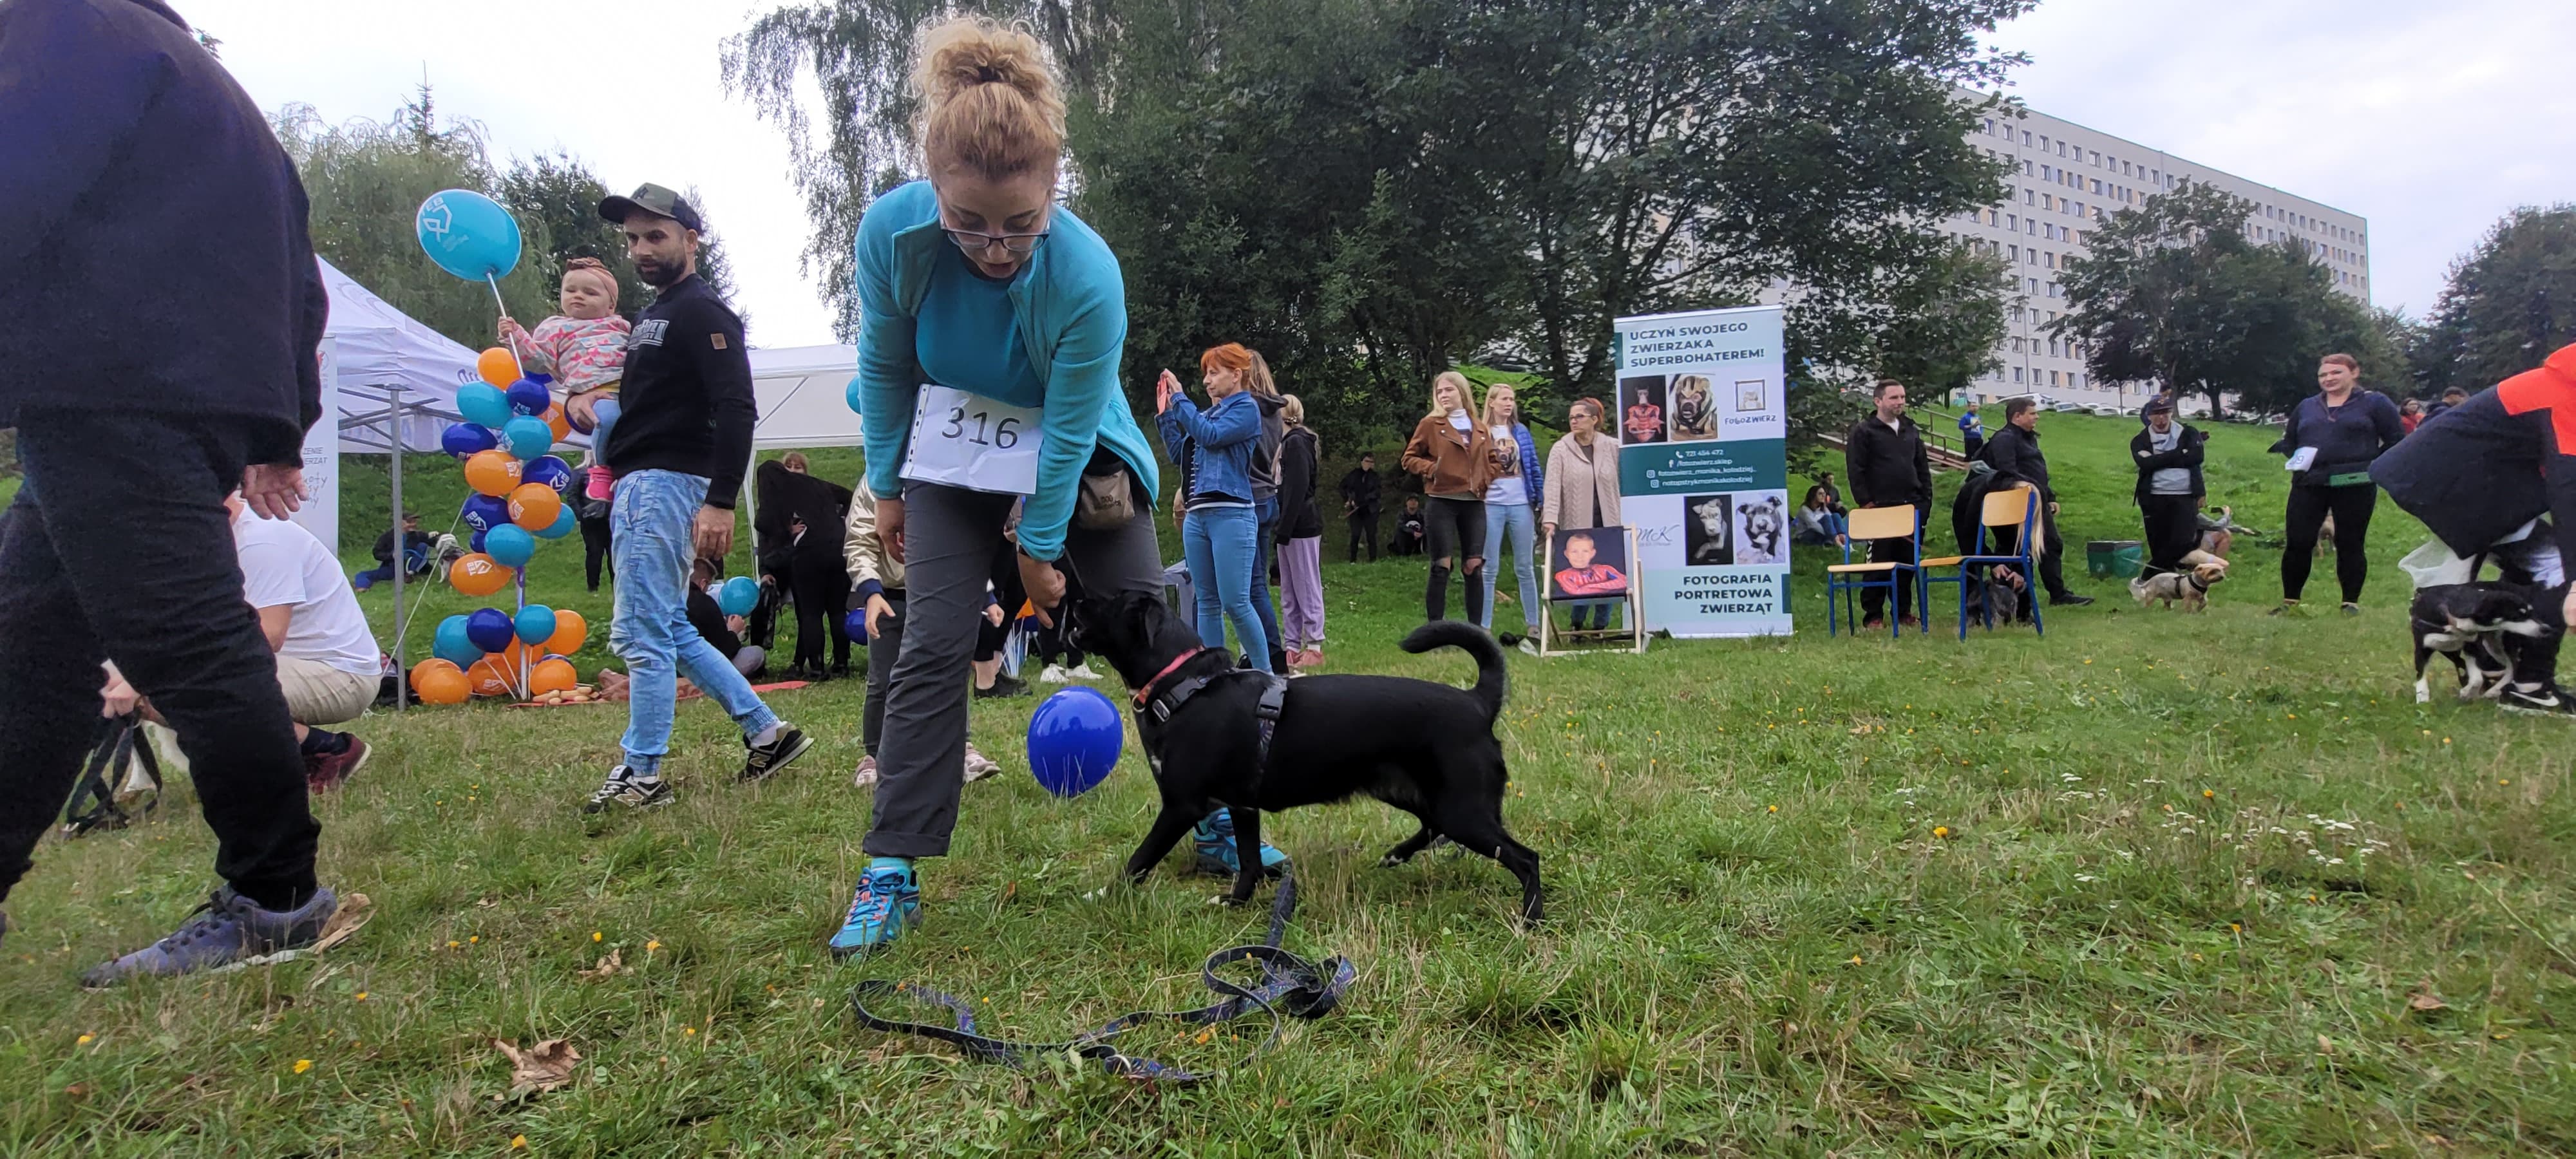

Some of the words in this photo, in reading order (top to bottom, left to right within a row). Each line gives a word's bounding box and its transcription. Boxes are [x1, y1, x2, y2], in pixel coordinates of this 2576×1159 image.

[1630, 326, 1675, 341] UCZYŃ
[1679, 322, 1748, 337] SWOJEGO
[1630, 339, 1714, 353] ZWIERZAKA
[1631, 348, 1765, 367] SUPERBOHATEREM!
[942, 406, 1021, 449] 316
[556, 469, 570, 483] TEB
[467, 563, 477, 576] TEB
[1683, 574, 1772, 585] FOTOGRAFIA
[1674, 589, 1772, 599] PORTRETOWA
[1700, 603, 1773, 614] ZWIERZĄT
